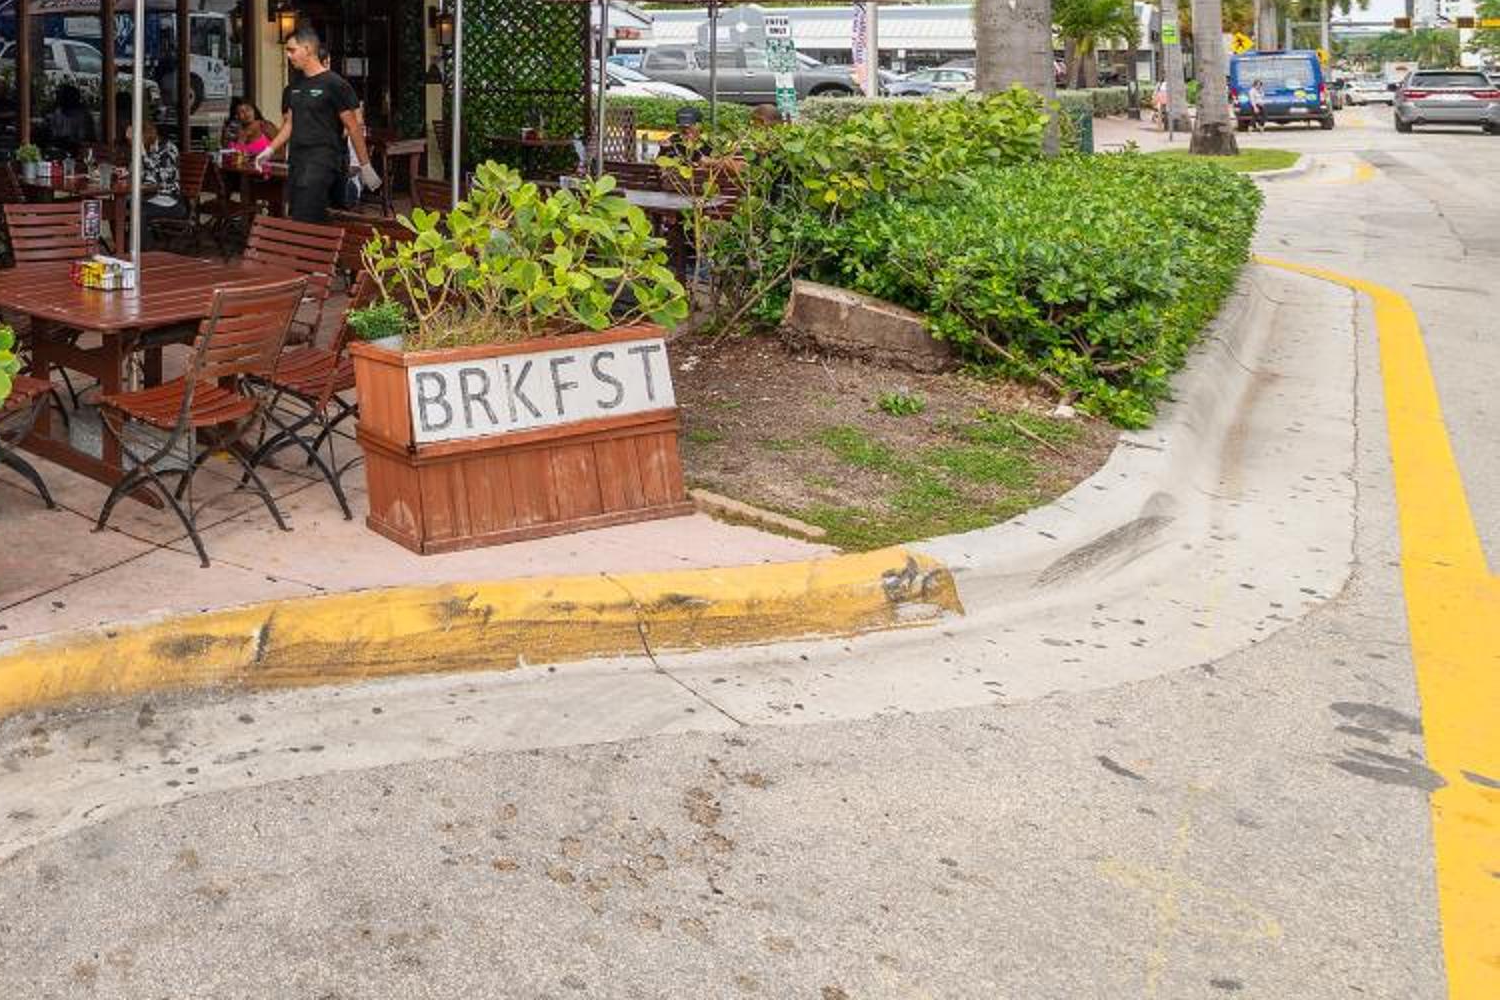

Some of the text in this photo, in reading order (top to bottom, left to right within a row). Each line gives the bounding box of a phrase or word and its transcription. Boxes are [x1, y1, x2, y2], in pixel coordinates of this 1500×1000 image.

[764, 17, 789, 25] ENTER
[769, 27, 787, 35] ONLY
[415, 344, 661, 432] BRKFST
